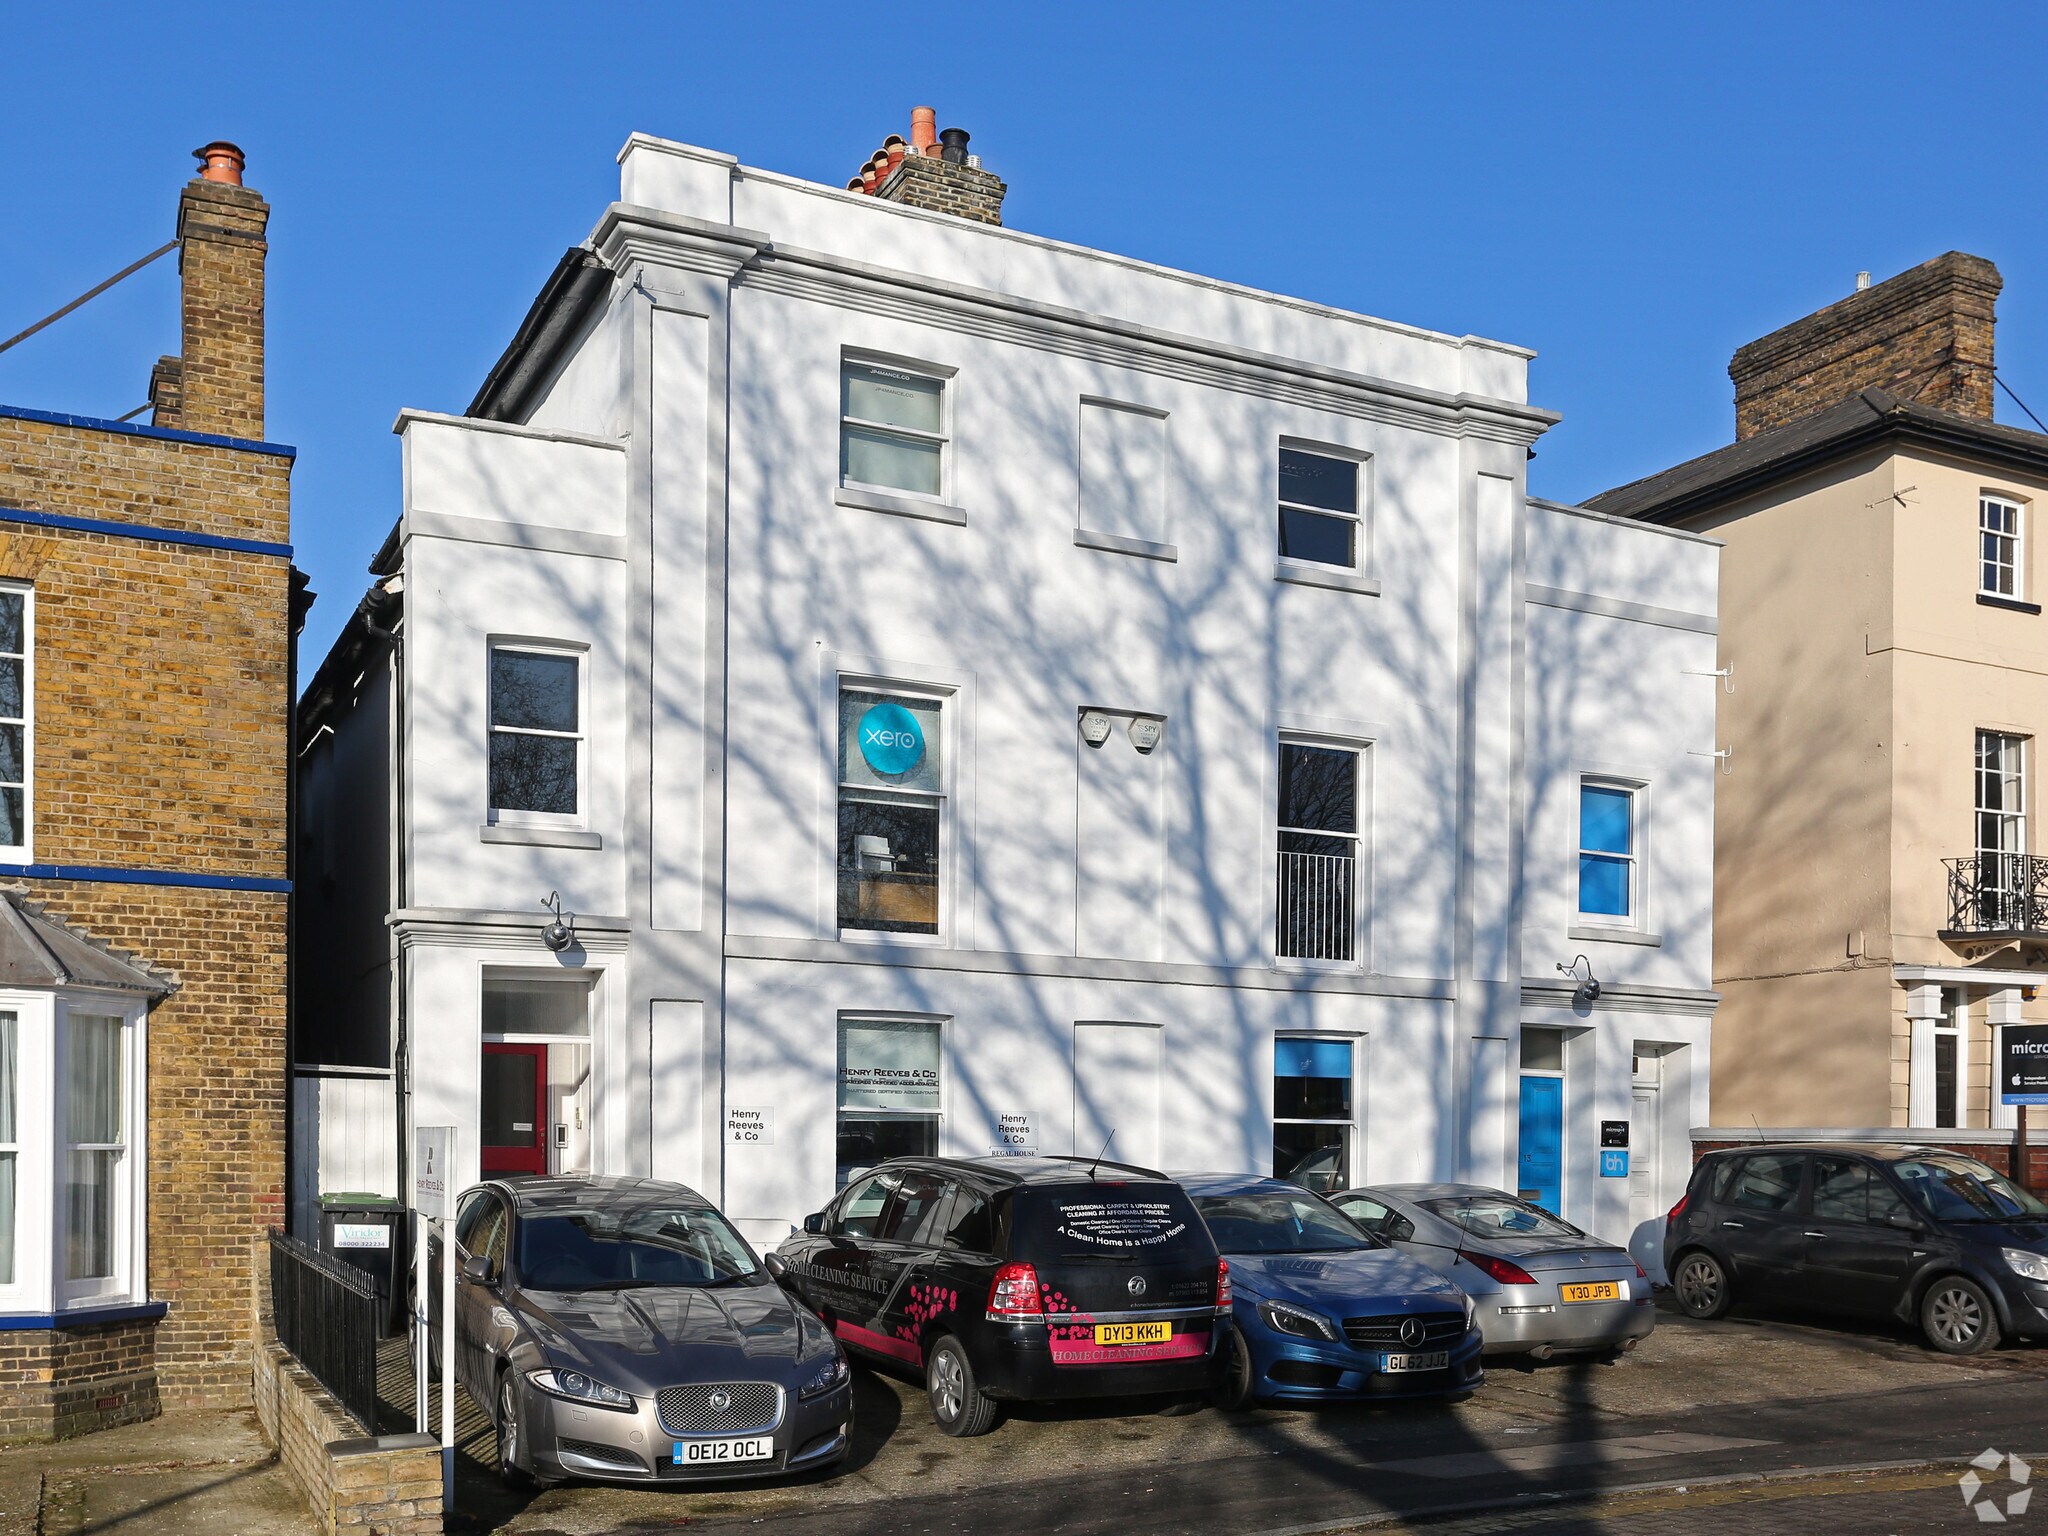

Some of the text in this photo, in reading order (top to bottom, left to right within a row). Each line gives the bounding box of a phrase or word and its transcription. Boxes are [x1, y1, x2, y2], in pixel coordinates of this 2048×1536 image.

[1095, 718, 1108, 727] SPY
[1144, 725, 1157, 733] SPY
[866, 728, 915, 749] xero
[840, 1067, 871, 1076] HENRY
[874, 1068, 910, 1078] REEVES
[912, 1070, 921, 1078] &
[732, 1110, 760, 1120] Henry
[1001, 1114, 1027, 1125] Henry
[728, 1120, 765, 1130] Reeves
[998, 1124, 1030, 1134] Reeves
[734, 1131, 759, 1141] & Co
[1003, 1135, 1025, 1144] & Co
[1059, 1204, 1106, 1212] PROFESSIONAL
[1066, 1210, 1098, 1218] CLEANING
[342, 1226, 384, 1239] Viridor
[1057, 1225, 1065, 1234] A
[1067, 1228, 1094, 1243] Clean
[1096, 1237, 1123, 1247] Home
[1125, 1238, 1132, 1247] is
[1142, 1233, 1167, 1246] Happy
[1166, 1223, 1186, 1238] Home
[850, 1271, 888, 1295] SERVICE
[1570, 1285, 1611, 1299] Y30 JPB
[1103, 1325, 1163, 1341] DY13 KKH
[1155, 1344, 1203, 1357] SERVICE
[1390, 1354, 1447, 1370] GL62 JJZ
[688, 1441, 766, 1460] OE12 OCL
